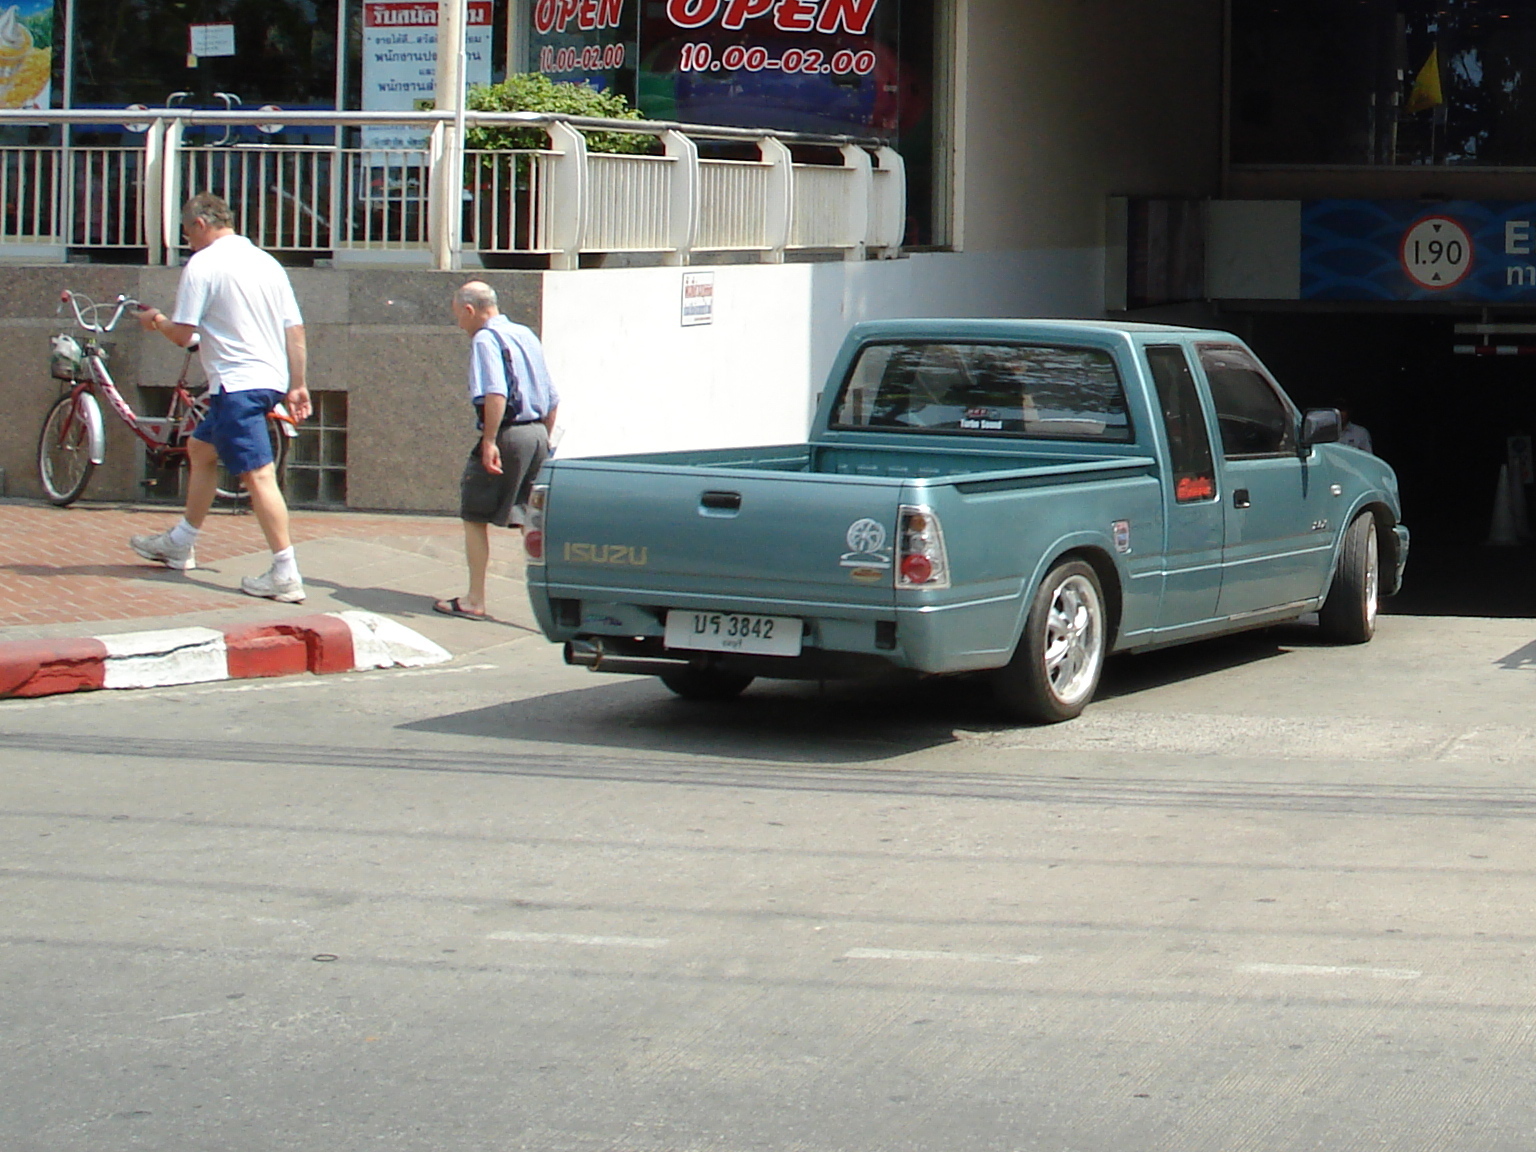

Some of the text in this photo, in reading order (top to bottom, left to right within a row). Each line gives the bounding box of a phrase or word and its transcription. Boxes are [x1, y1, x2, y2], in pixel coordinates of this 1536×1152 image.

[540, 43, 626, 74] 10.00-02.00
[680, 43, 876, 75] 10.00-02.00
[564, 541, 648, 566] ISUZU
[727, 616, 775, 639] 3842
